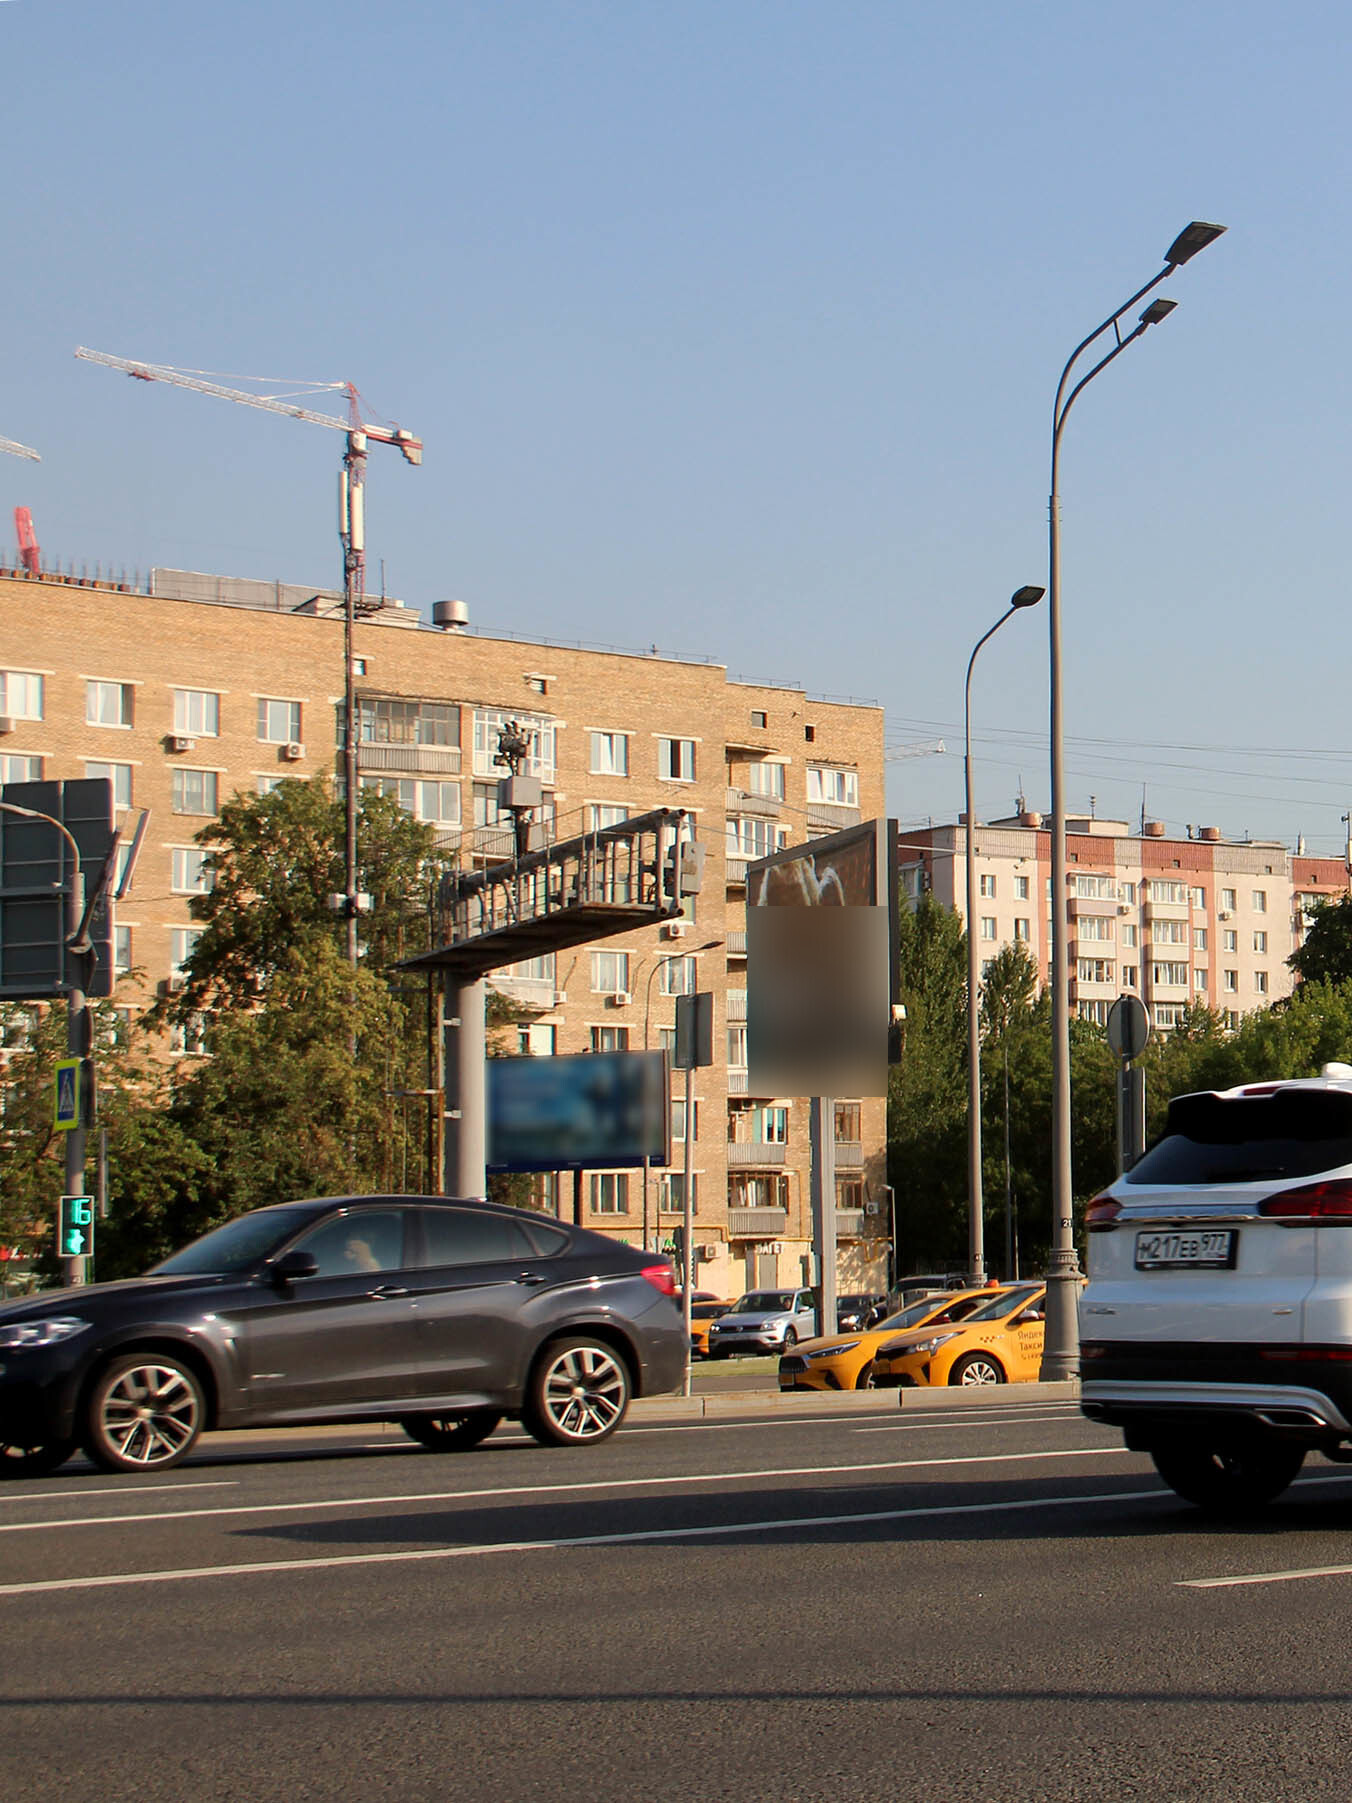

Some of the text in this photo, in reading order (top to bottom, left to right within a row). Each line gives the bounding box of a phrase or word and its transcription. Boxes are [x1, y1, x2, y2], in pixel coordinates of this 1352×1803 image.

[71, 1198, 91, 1226] 16
[1017, 1330, 1043, 1340] Яндек
[1019, 1342, 1042, 1351] Такси
